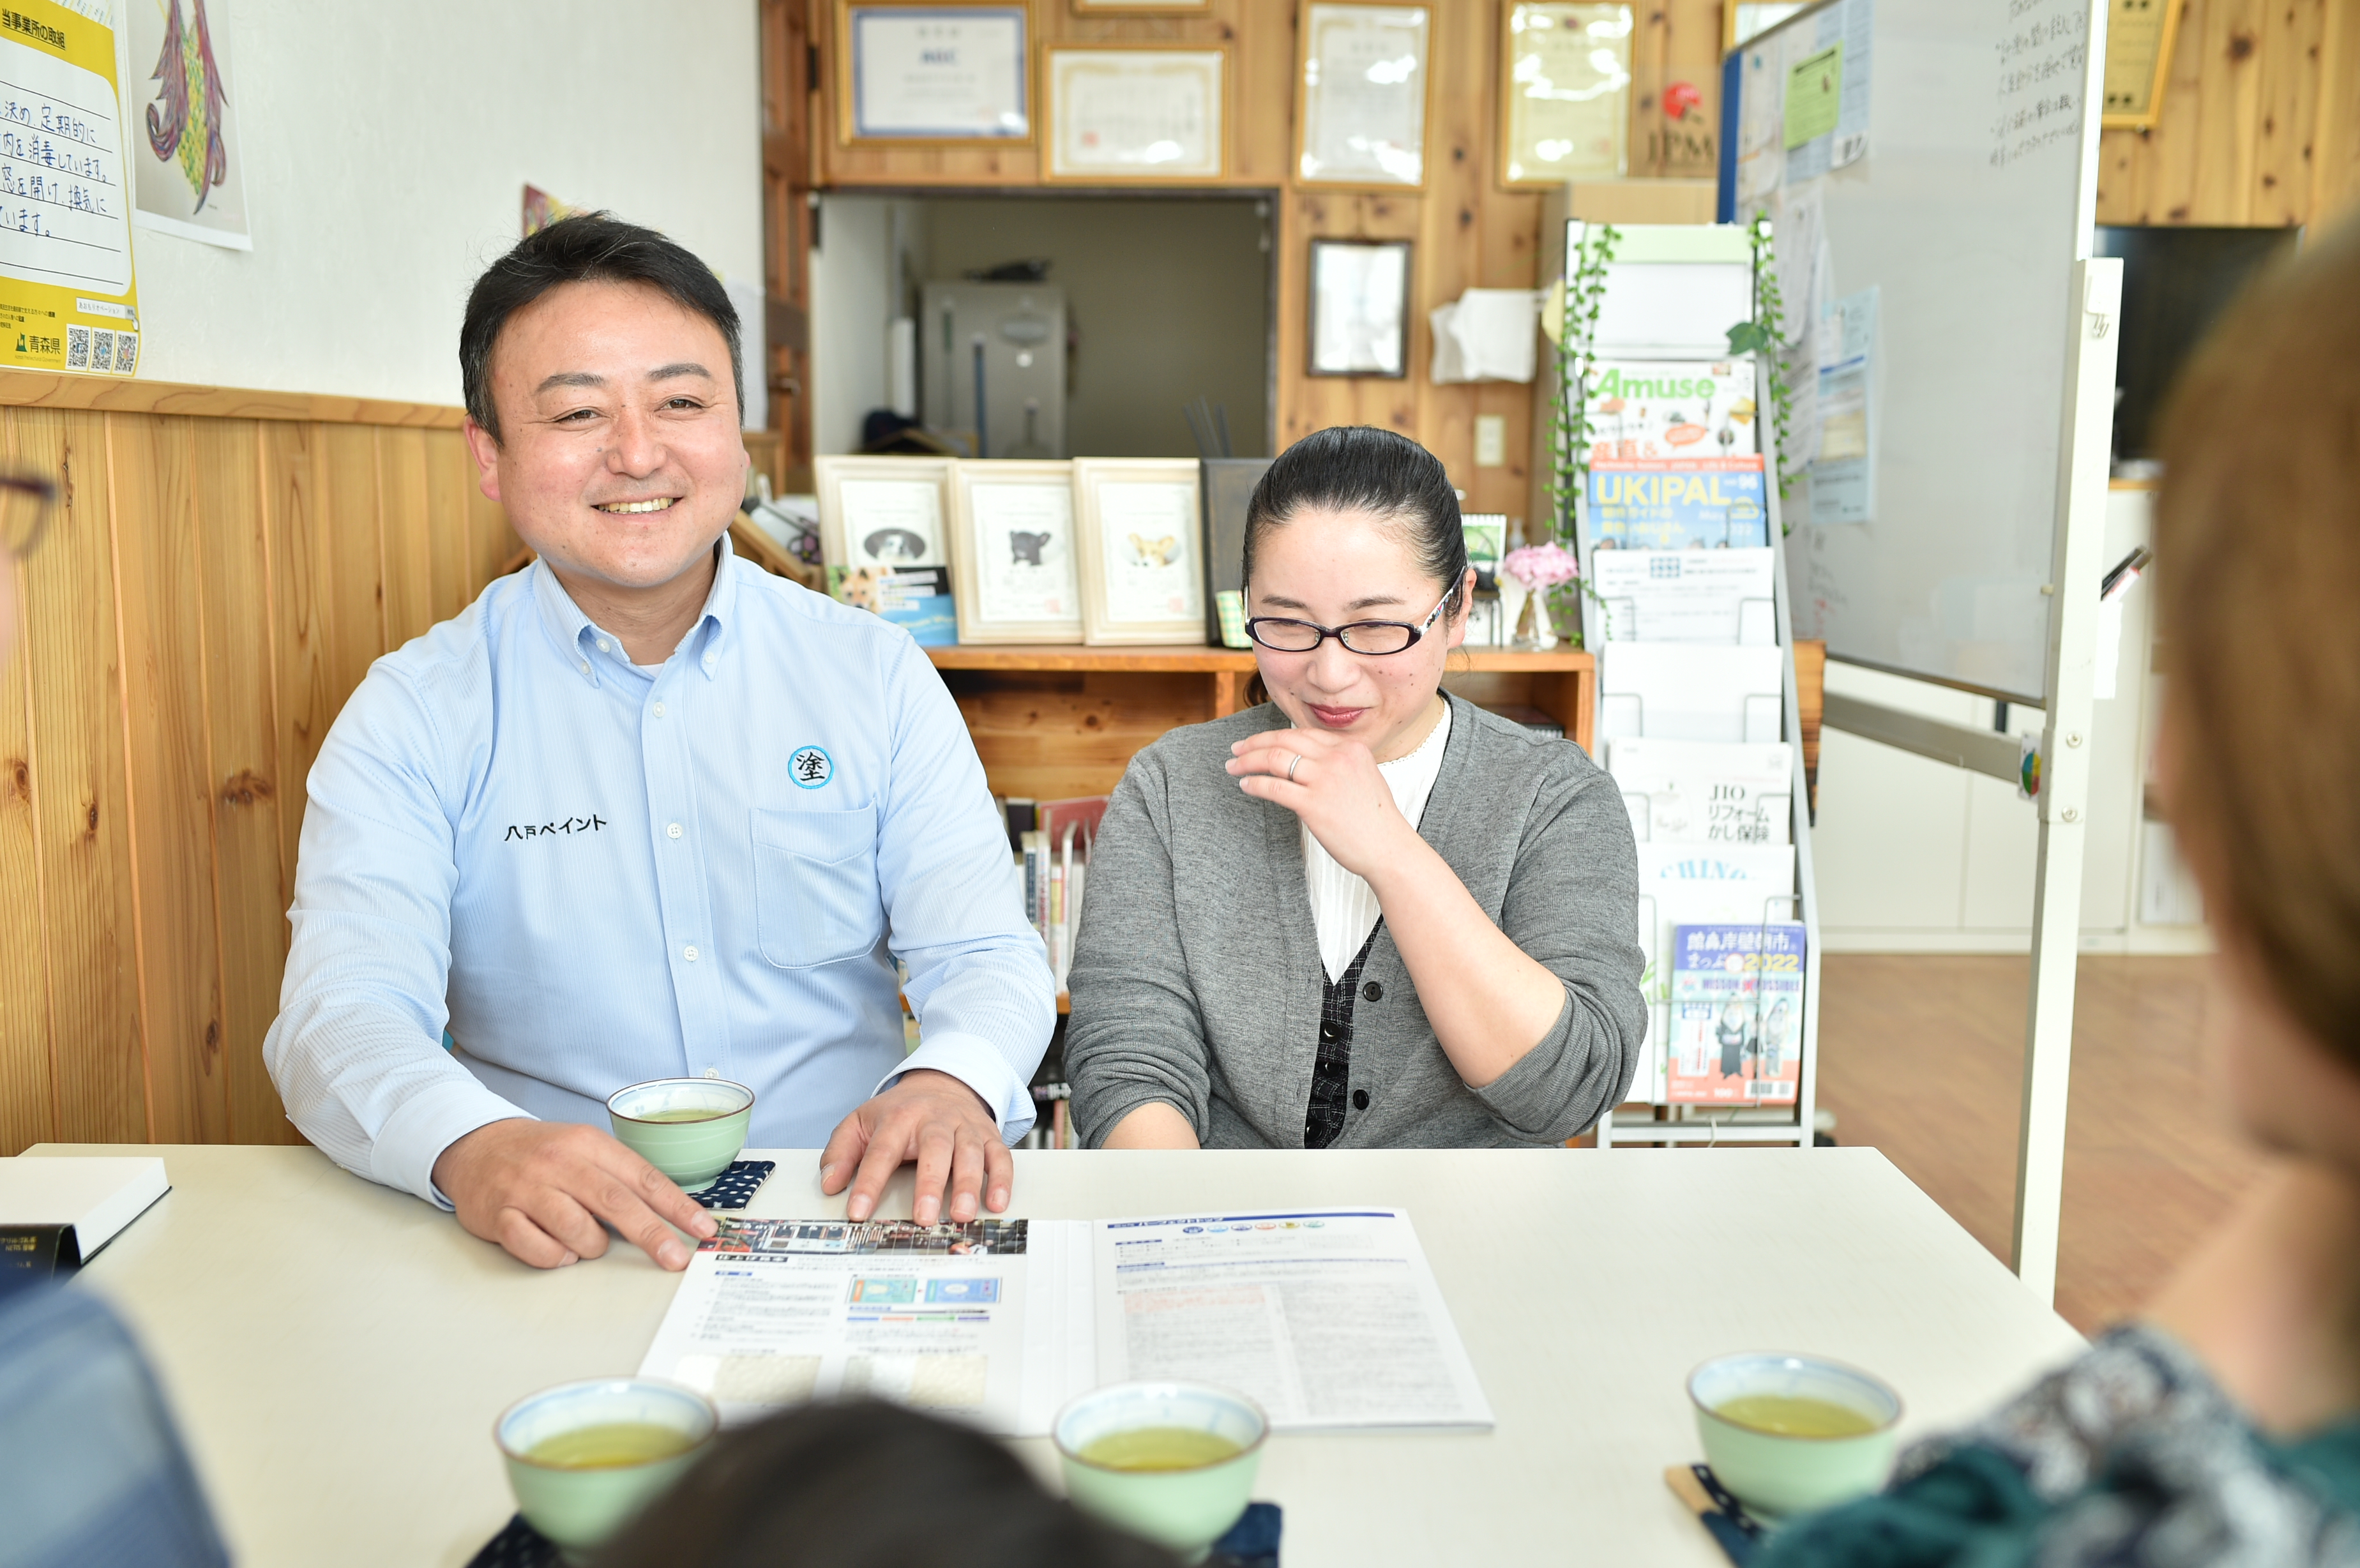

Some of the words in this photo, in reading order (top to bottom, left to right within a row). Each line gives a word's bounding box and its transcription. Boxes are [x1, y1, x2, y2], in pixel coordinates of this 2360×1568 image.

[2, 8, 66, 49] 当事業所の取組
[29, 335, 61, 354] 青森県
[1596, 368, 1716, 398] Amuse
[1597, 475, 1732, 506] UKIPAL
[796, 751, 826, 782] 塗
[1709, 785, 1746, 801] JIO
[1708, 804, 1769, 823] リフォーム
[504, 813, 607, 841] 八戸ペイント
[1708, 824, 1769, 841] かし保険
[1744, 953, 1799, 972] 2022
